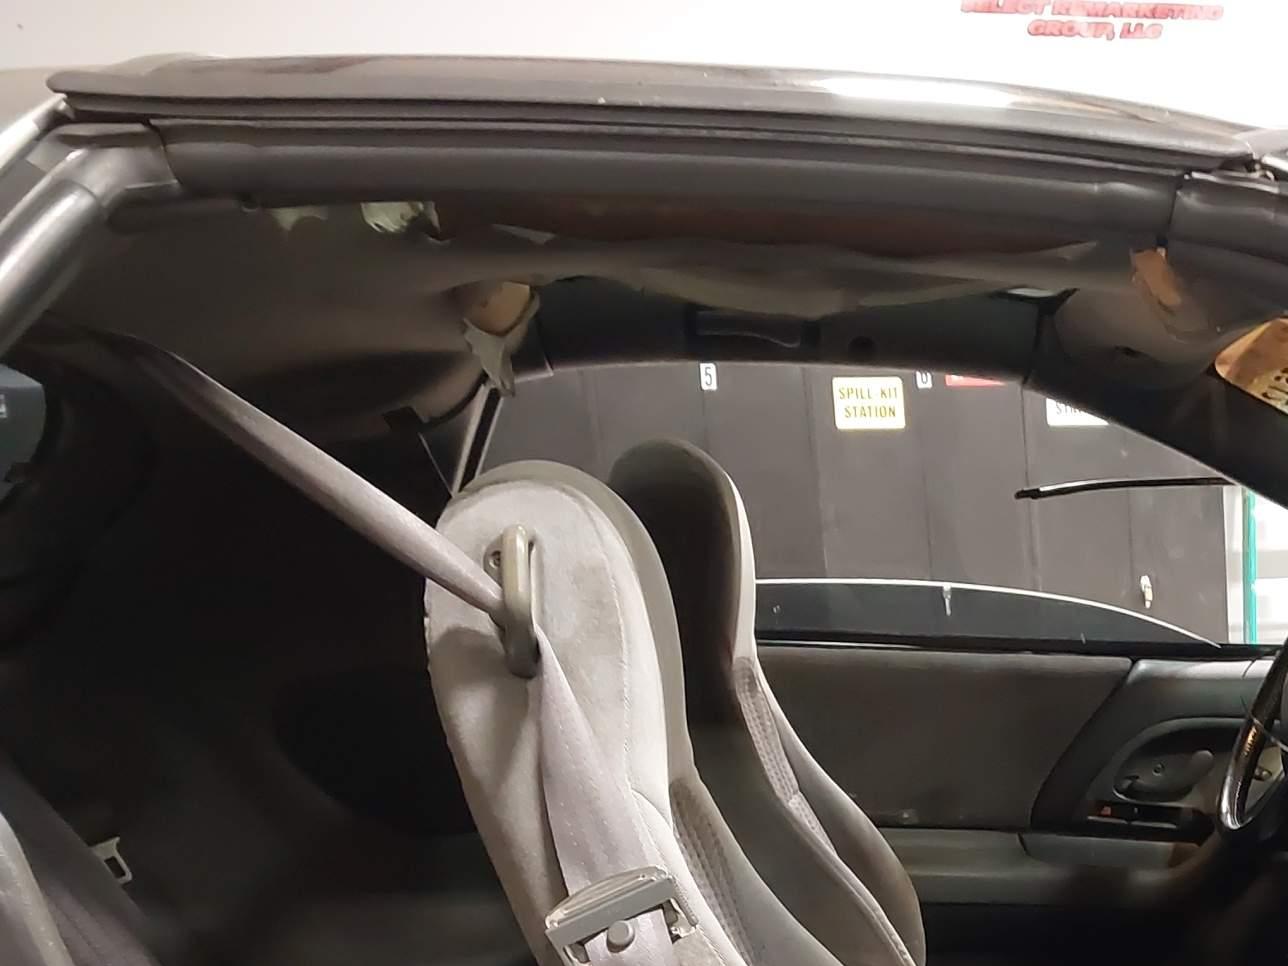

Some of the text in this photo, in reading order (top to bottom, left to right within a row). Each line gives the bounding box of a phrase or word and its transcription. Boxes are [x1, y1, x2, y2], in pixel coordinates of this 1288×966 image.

[1052, 0, 1224, 20] REMARKETING
[1027, 19, 1164, 41] GROUP, LLC
[704, 366, 713, 386] 5
[838, 386, 898, 400] SPILL KIT
[844, 405, 896, 418] STATION
